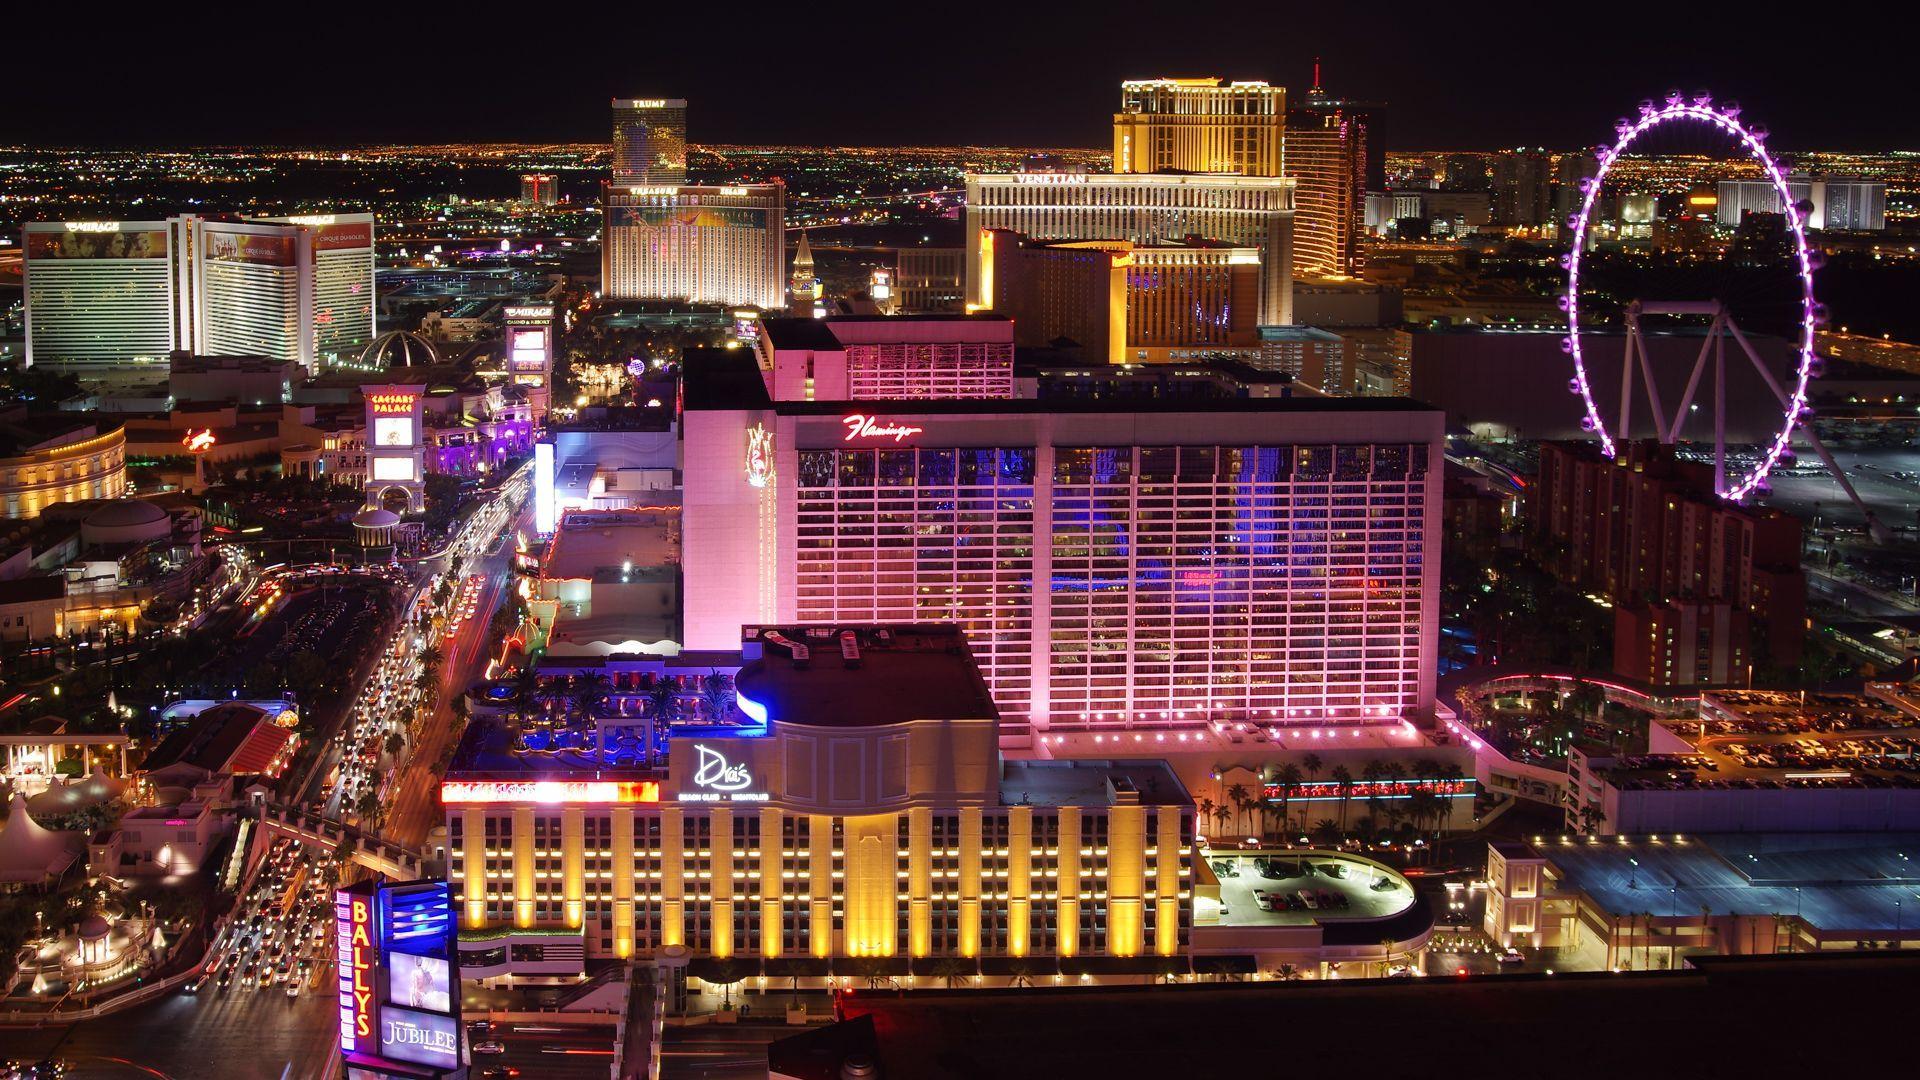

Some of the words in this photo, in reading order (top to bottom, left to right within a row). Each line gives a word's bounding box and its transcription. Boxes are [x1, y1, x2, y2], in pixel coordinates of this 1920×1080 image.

[633, 100, 665, 108] TRUMP
[1017, 174, 1086, 184] VENETIAN
[630, 187, 678, 195] TREASURE
[79, 222, 119, 232] MIRAGE
[515, 308, 552, 317] MIRAGE
[372, 395, 414, 404] CAESARS
[374, 404, 412, 413] PALACE
[843, 414, 922, 442] Flamingo
[382, 1021, 456, 1050] JUBILEE
